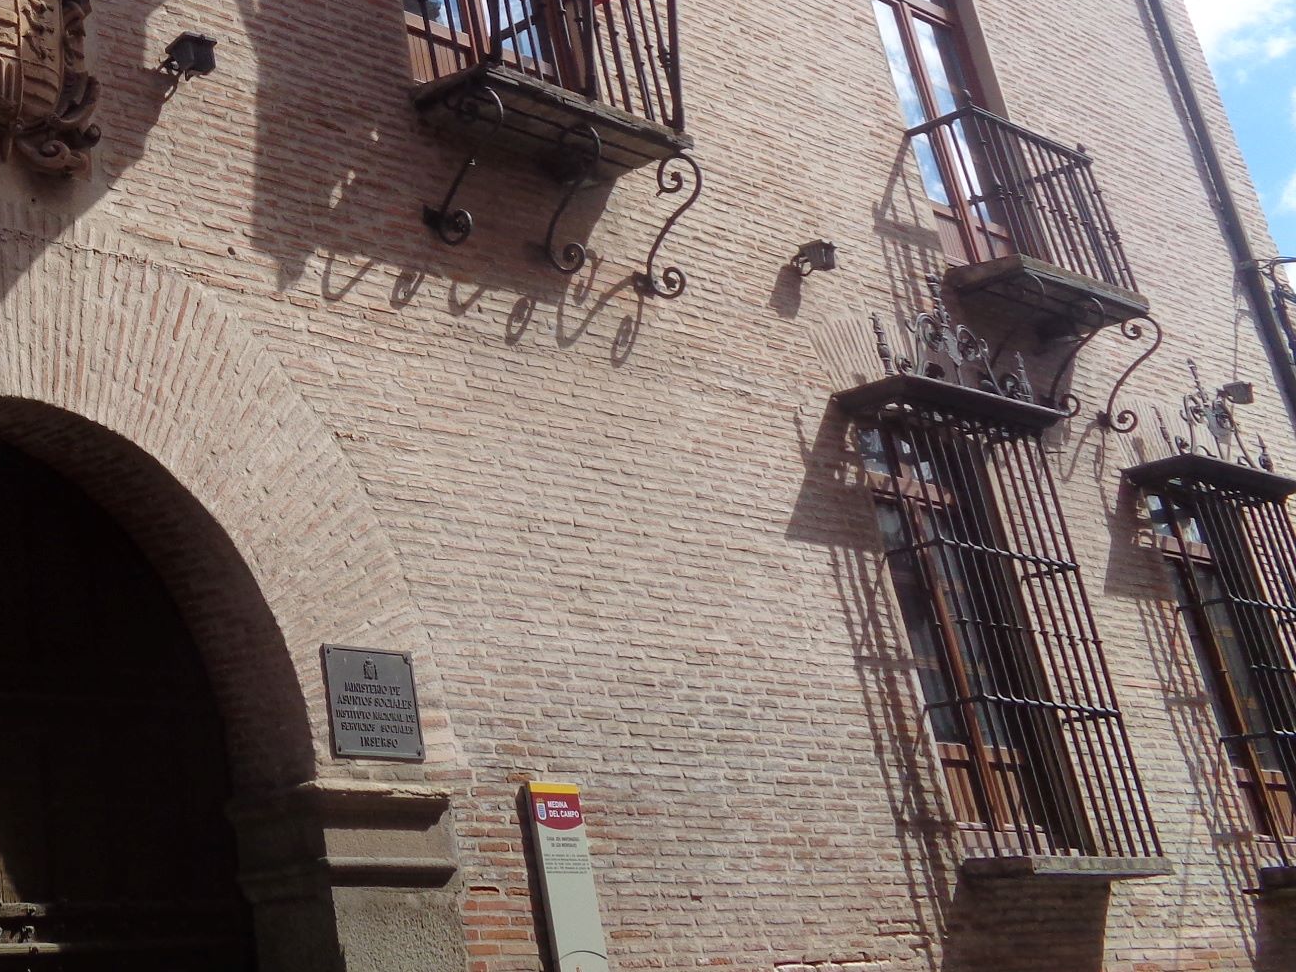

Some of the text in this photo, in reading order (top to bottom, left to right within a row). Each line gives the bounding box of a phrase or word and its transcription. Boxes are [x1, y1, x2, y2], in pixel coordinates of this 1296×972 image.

[344, 681, 401, 696] MINISTERIO DE
[337, 694, 413, 710] ASUNTOS SOCIALES
[405, 714, 416, 723] DE
[340, 721, 415, 735] SERVICIOS SOCIALES
[360, 736, 399, 748] INSERSO
[547, 800, 569, 808] MEDINA
[548, 810, 580, 818] DEL CAMPO
